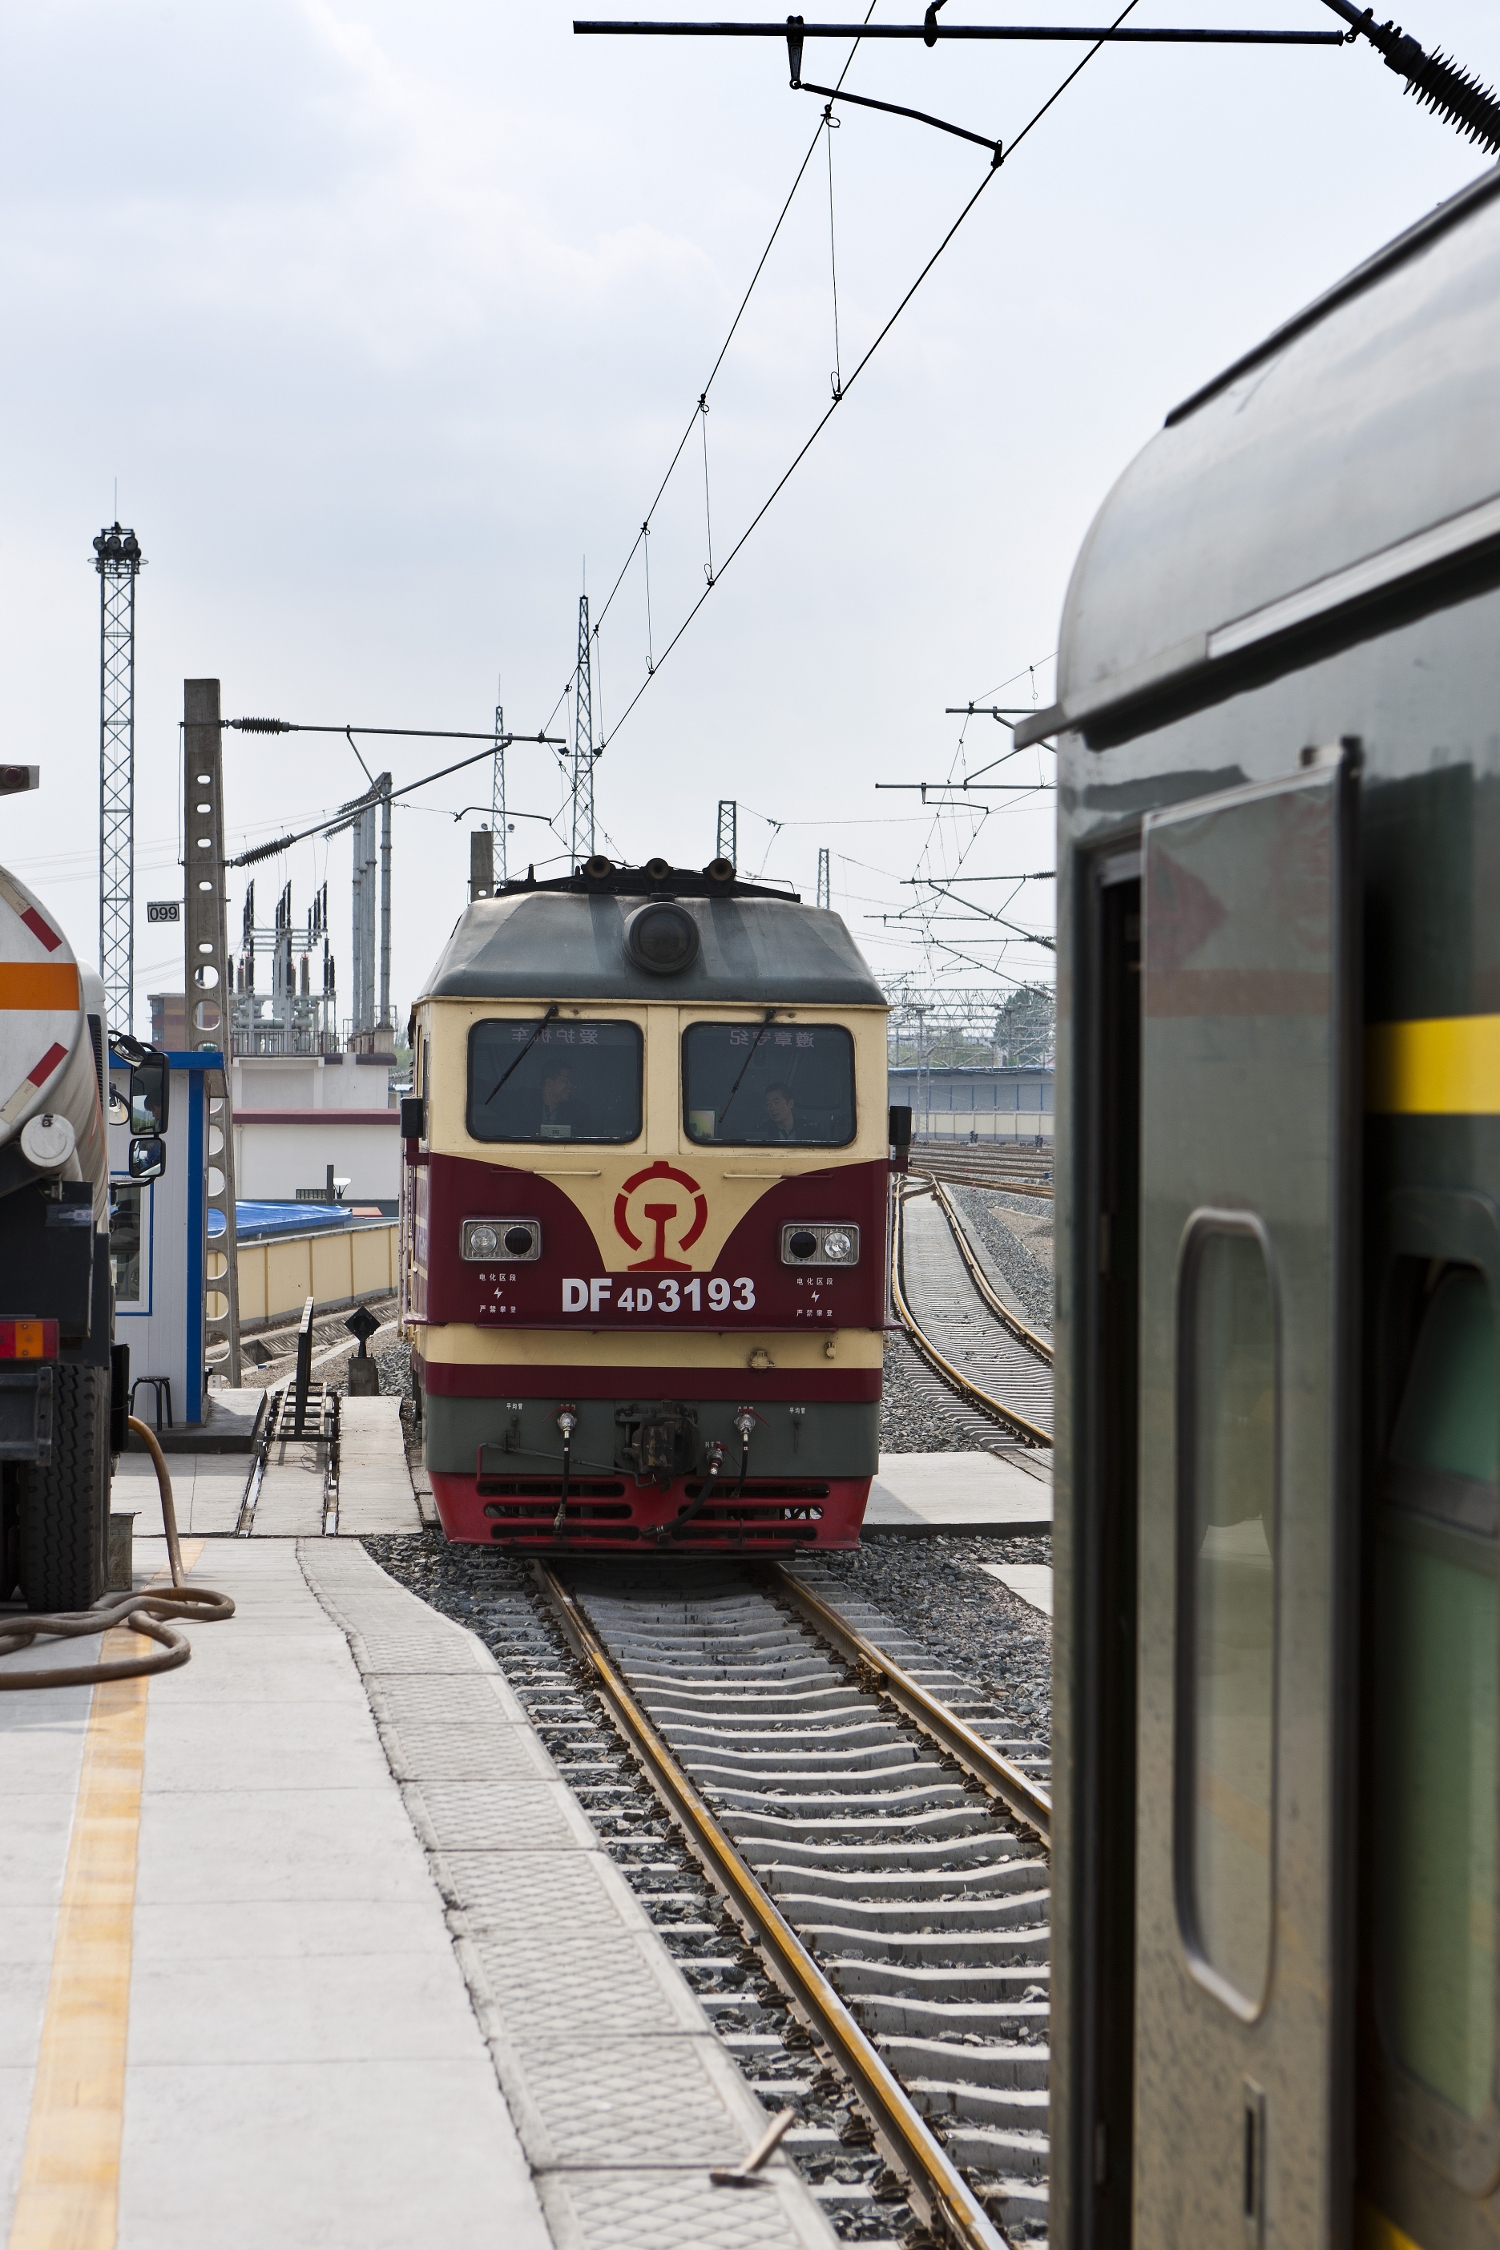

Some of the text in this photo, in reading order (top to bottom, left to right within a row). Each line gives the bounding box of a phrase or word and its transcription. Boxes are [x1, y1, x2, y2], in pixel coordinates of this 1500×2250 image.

[150, 906, 177, 920] 099
[479, 1273, 516, 1282] 电化区段
[796, 1277, 833, 1286] 电化区段
